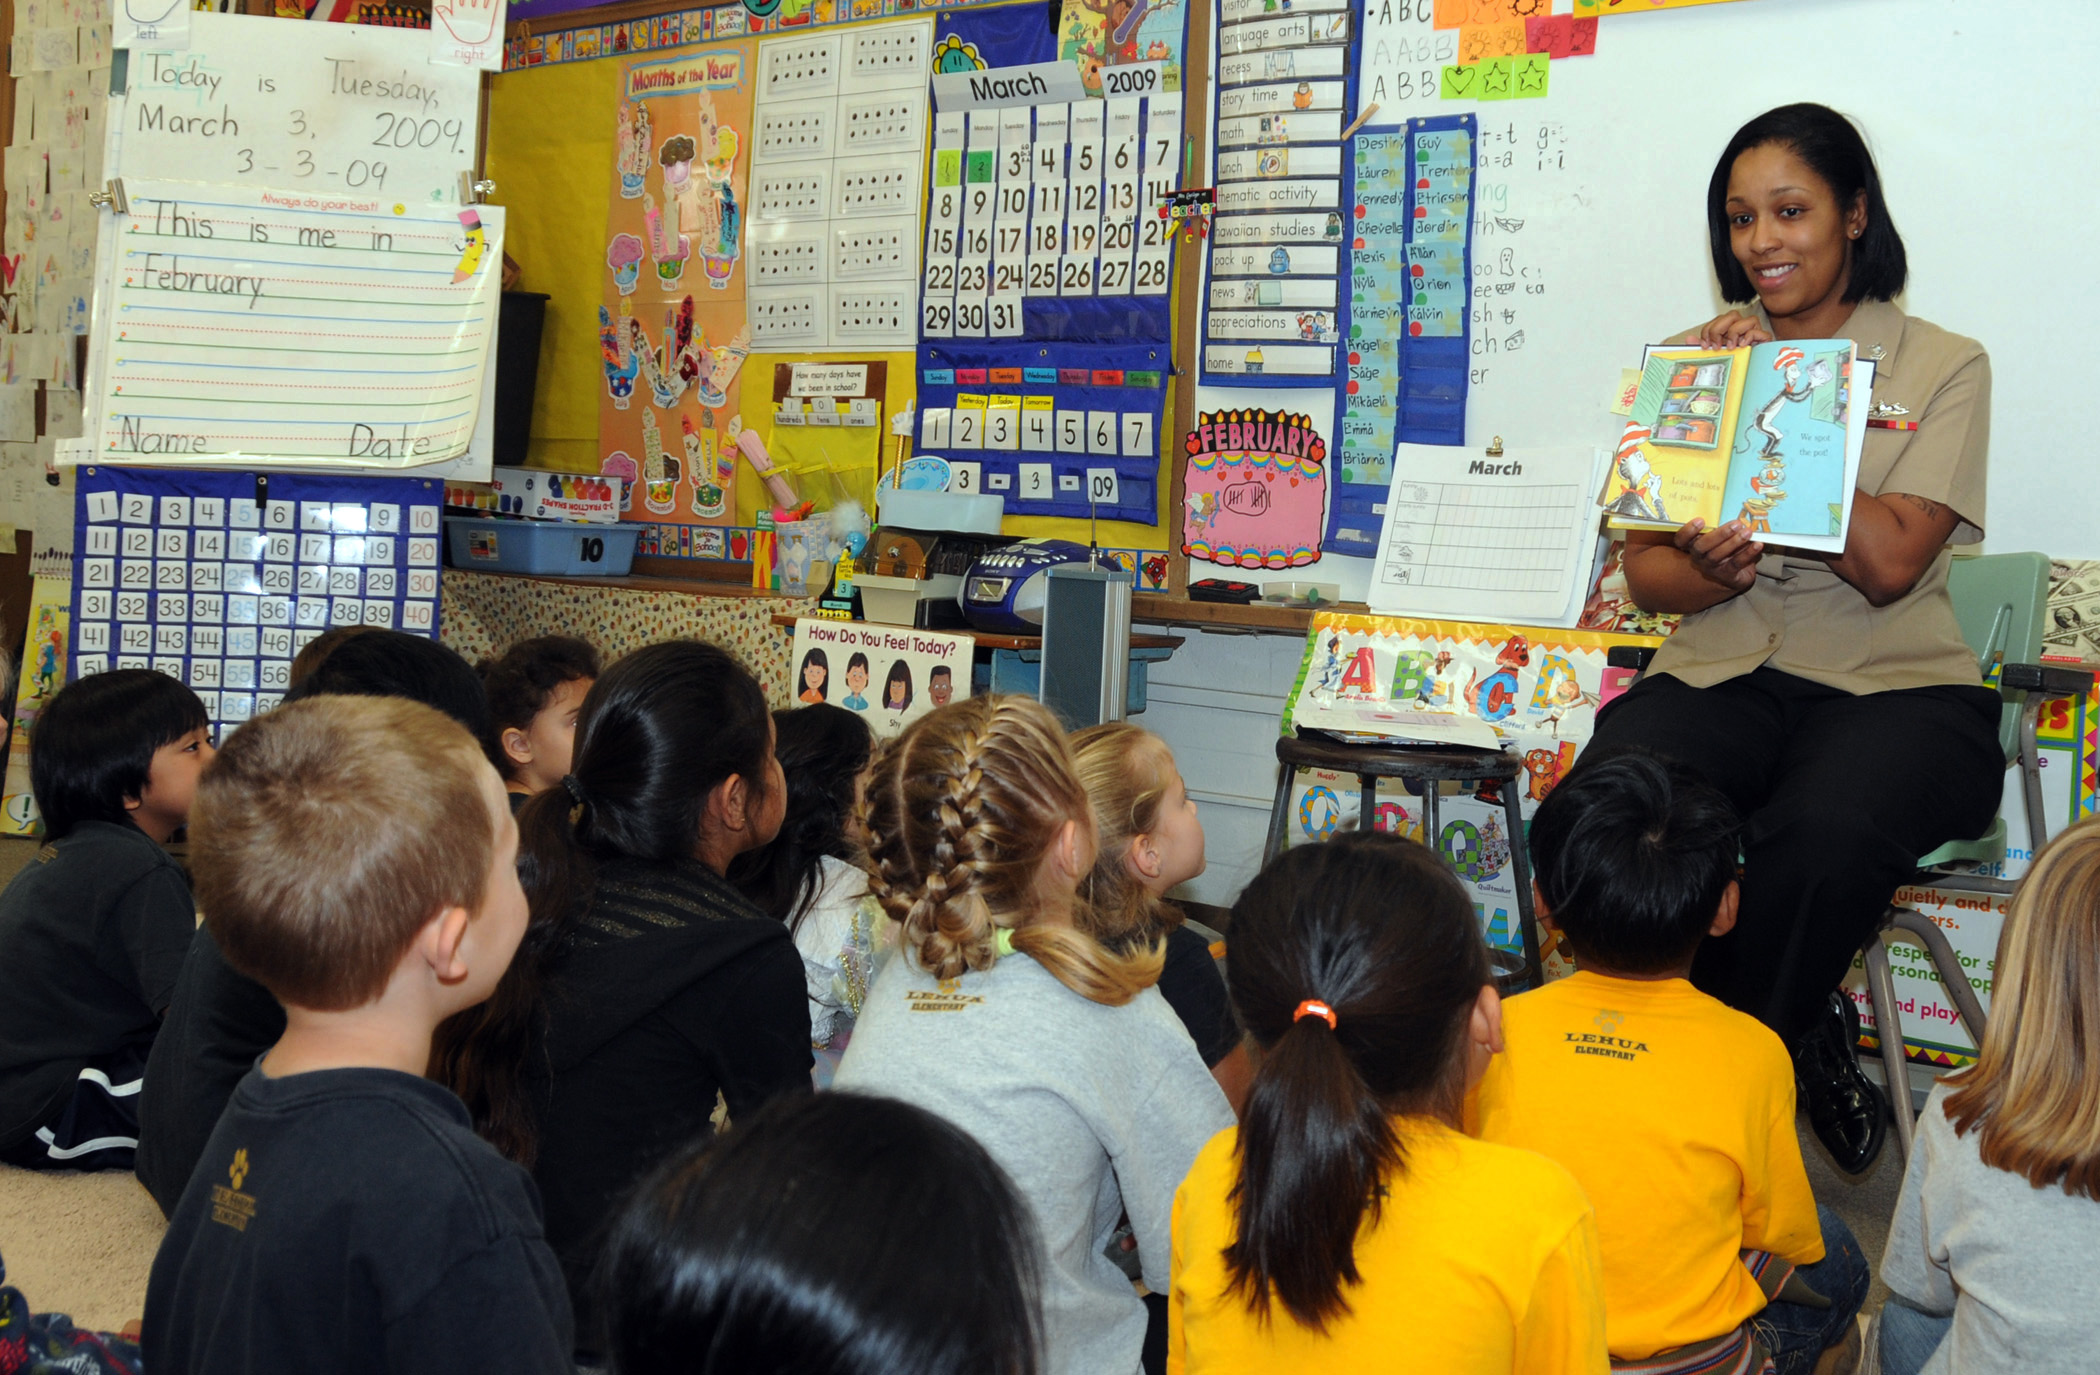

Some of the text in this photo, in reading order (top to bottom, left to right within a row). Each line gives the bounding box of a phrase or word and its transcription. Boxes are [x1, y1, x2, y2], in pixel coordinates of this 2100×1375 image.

[136, 25, 158, 39] left
[1221, 22, 1305, 48] language arts
[454, 50, 485, 65] right
[632, 58, 737, 93] Months of the Year
[1221, 62, 1251, 76] recess
[147, 53, 439, 115] Today is Tuesday,
[970, 69, 1156, 101] March 2009
[1221, 88, 1278, 111] story time
[138, 102, 464, 153] March 3, 2009.
[974, 124, 994, 132] Monday
[1004, 123, 1024, 131] Tuesday
[1038, 119, 1066, 127] Wednesday
[1075, 116, 1098, 124] Thursday
[1114, 113, 1130, 121] Friday
[1152, 109, 1176, 118] Saturday
[1220, 121, 1244, 141] math
[1357, 135, 1406, 150] Destiny
[1416, 136, 1442, 151] Guy
[1219, 156, 1243, 175] lunch
[1357, 166, 1396, 179] Lauren
[261, 193, 379, 213] Always do your best!
[940, 180, 1169, 218] 8 9 10 11 12 13 14
[1218, 184, 1317, 208] thematic activity
[1356, 191, 1404, 206] Kennedy
[1164, 197, 1217, 219] Teacher
[149, 199, 393, 251] This is me in
[1215, 218, 1316, 238] hawaiian studies
[1356, 220, 1404, 235] Chevelle
[1415, 219, 1459, 234] Jordan
[1473, 210, 1495, 236] th
[1353, 250, 1386, 264] Alexis
[1409, 246, 1437, 259] Allan
[1214, 250, 1255, 273] pack up
[1473, 264, 1493, 276] oo
[143, 253, 265, 310] February.
[927, 260, 1166, 291] 22 23 24 25 26 27 28
[1353, 275, 1376, 291] Nyla
[1412, 276, 1452, 291] Orion
[1212, 286, 1235, 298] news
[1473, 285, 1493, 298] ee
[1408, 304, 1444, 321] Kalvin
[1472, 302, 1493, 323] sh
[1209, 314, 1286, 336] appreciations
[1472, 327, 1498, 356] ch
[1207, 351, 1234, 369] home
[796, 370, 862, 380] How many days have
[1349, 366, 1380, 381] Sage
[1470, 368, 1489, 385] er
[808, 384, 824, 392] been
[833, 382, 857, 392] school?
[960, 394, 1051, 406] Yesterday Today Tomorrow
[122, 415, 431, 459] Name Date
[961, 416, 973, 442] 2
[994, 417, 1007, 442] 3
[1031, 417, 1044, 444] 4
[1064, 419, 1076, 445] 5
[1096, 420, 1108, 447] 6
[1131, 421, 1143, 449] 7
[1344, 422, 1374, 436] Emma
[1199, 421, 1317, 459] FEBRUARY
[1800, 433, 1831, 443] We spot
[1343, 451, 1386, 466] Brianna
[1800, 449, 1829, 458] the pot!
[1467, 459, 1523, 476] March
[959, 469, 1113, 498] 3 3 09
[1672, 476, 1721, 491] Lots and lots
[1668, 492, 1679, 502] of
[94, 531, 109, 549] 11
[127, 534, 147, 551] 12
[162, 534, 182, 553] 13
[199, 535, 219, 553] 14
[269, 538, 289, 556] 16
[304, 539, 324, 556] 17
[370, 541, 389, 559] 19
[410, 543, 434, 561] 20
[580, 537, 604, 563] 10
[808, 625, 957, 660] How Do You Feel Today?
[1338, 647, 1377, 693] A
[1476, 672, 1519, 722] C
[1529, 654, 1577, 708] D
[1499, 720, 1526, 731] Clifford
[1477, 883, 1512, 895] Quiltmaker
[1954, 896, 1992, 913] and
[905, 991, 984, 1003] LEHUA
[1920, 1001, 1961, 1025] play
[1564, 1033, 1651, 1053] LEHUA
[1575, 1045, 1636, 1061] ELEMENTARY
